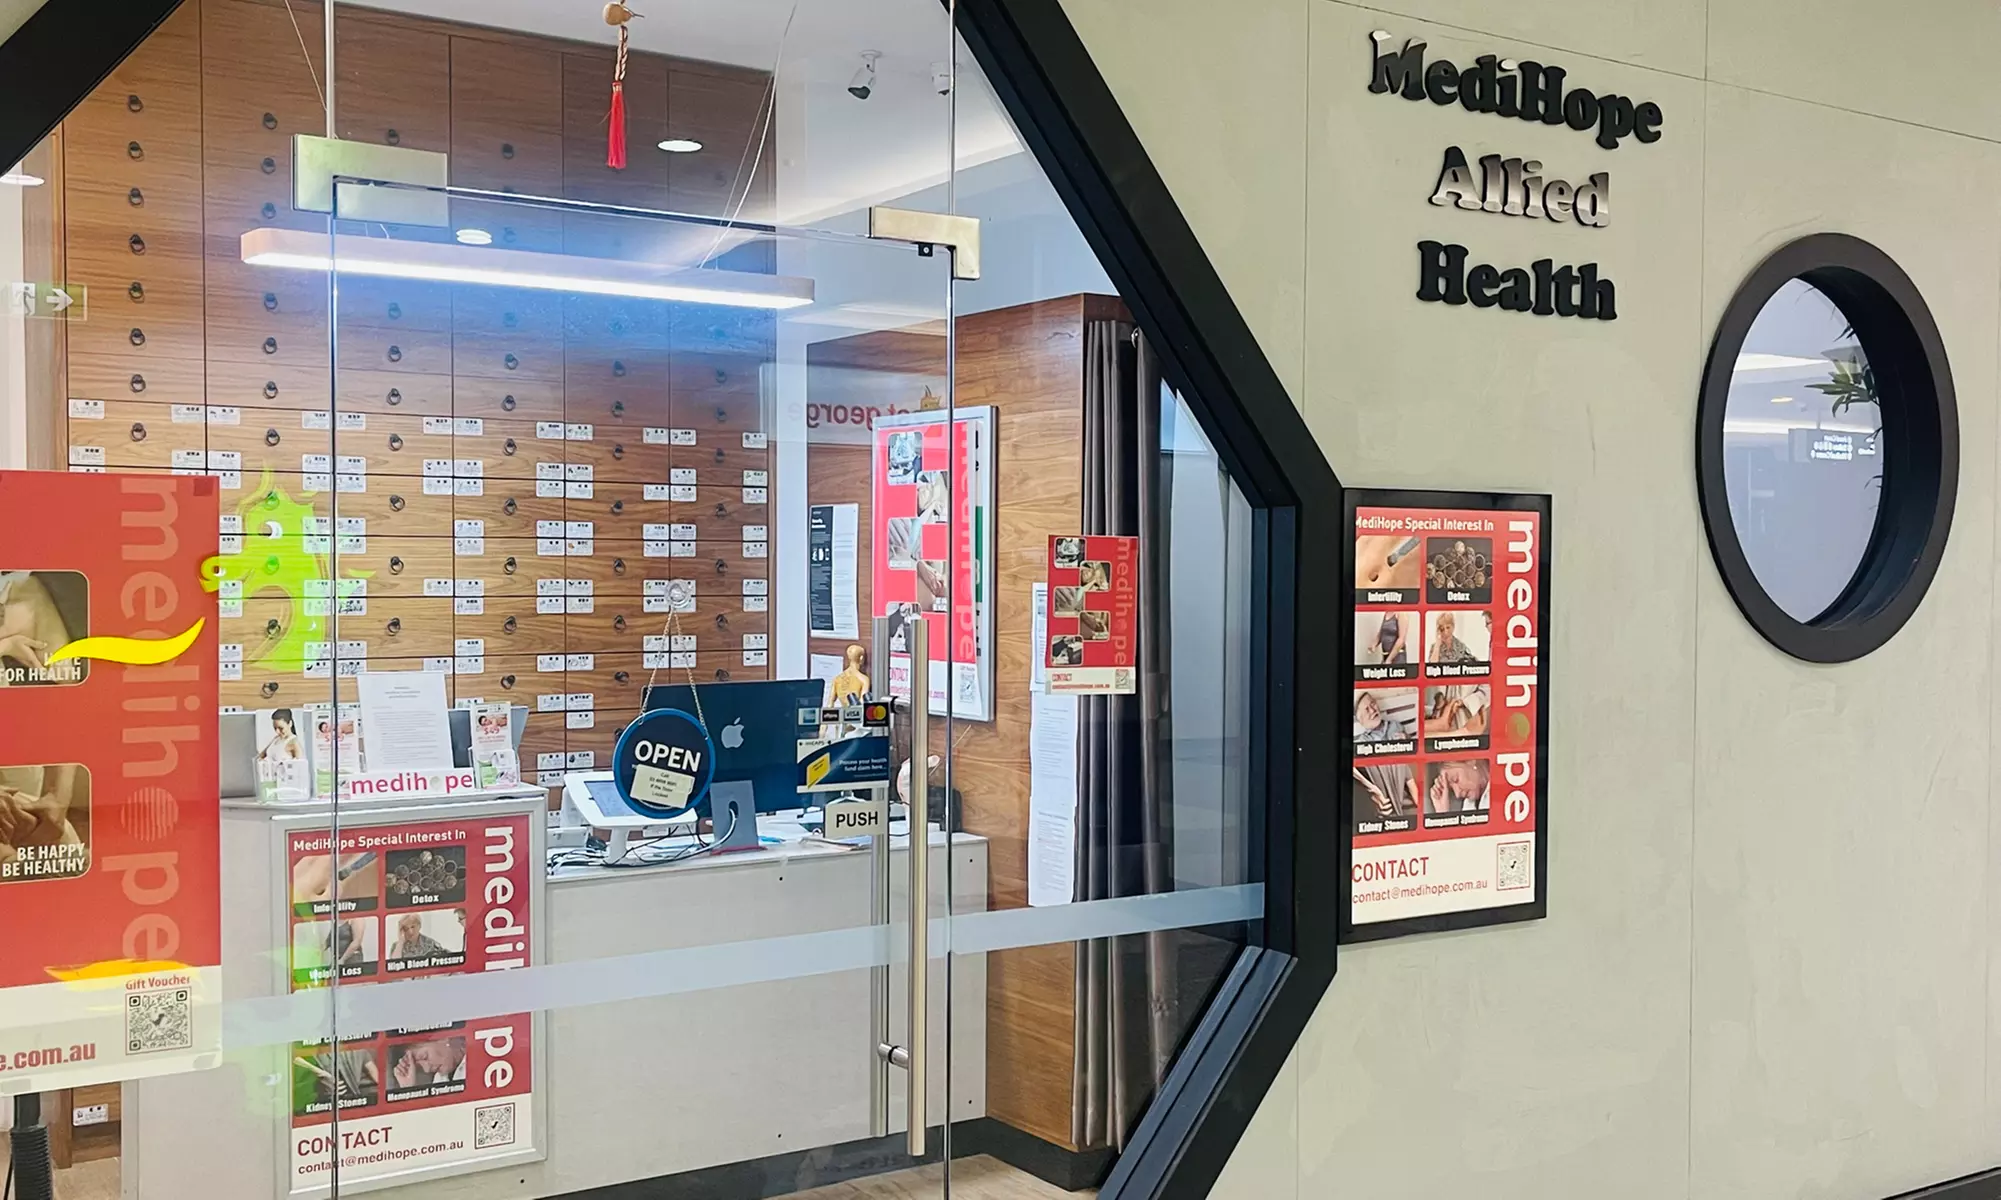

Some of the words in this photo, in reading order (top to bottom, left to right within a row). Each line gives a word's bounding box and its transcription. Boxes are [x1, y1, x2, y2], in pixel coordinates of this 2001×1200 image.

[1368, 30, 1663, 149] MediHope
[1428, 146, 1611, 227] Allied
[1416, 241, 1618, 321] Health
[1405, 518, 1442, 533] Special
[1443, 518, 1482, 531] Interest
[1484, 519, 1494, 531] In
[1367, 591, 1402, 603] Infertility
[1447, 591, 1470, 601] Detox
[29, 666, 81, 681] HEALTH
[1363, 668, 1387, 679] Weight
[1389, 667, 1406, 677] Loss
[1426, 666, 1441, 676] High
[635, 740, 701, 772] OPEN
[1357, 744, 1373, 755] High
[836, 811, 878, 828] PUSH
[1358, 822, 1382, 833] Kidney
[1384, 819, 1408, 830] Stones
[293, 837, 355, 851] MediHpe
[358, 834, 402, 849] Special
[405, 831, 451, 844] Interest
[455, 830, 466, 840] In
[17, 845, 36, 861] BE
[38, 843, 85, 860] HAPPY
[2, 862, 22, 877] BE
[24, 857, 85, 875] HEALTHY
[1352, 857, 1429, 882] CONTACT
[412, 894, 439, 904] Detox
[1352, 879, 1488, 904] contact@medihope.com.au
[388, 961, 405, 971] High
[407, 958, 429, 969] Blood
[431, 954, 464, 966] Pressure
[475, 826, 525, 1088] medipe
[342, 967, 362, 976] Loss
[125, 978, 146, 991] Gift
[148, 975, 191, 988] Voucher
[431, 1084, 465, 1095] Syndrome
[305, 1102, 332, 1113] Kidney
[338, 1097, 367, 1108] Stones
[297, 1126, 392, 1156] CONTACT
[298, 1140, 464, 1174] contat@medihope.com.au
